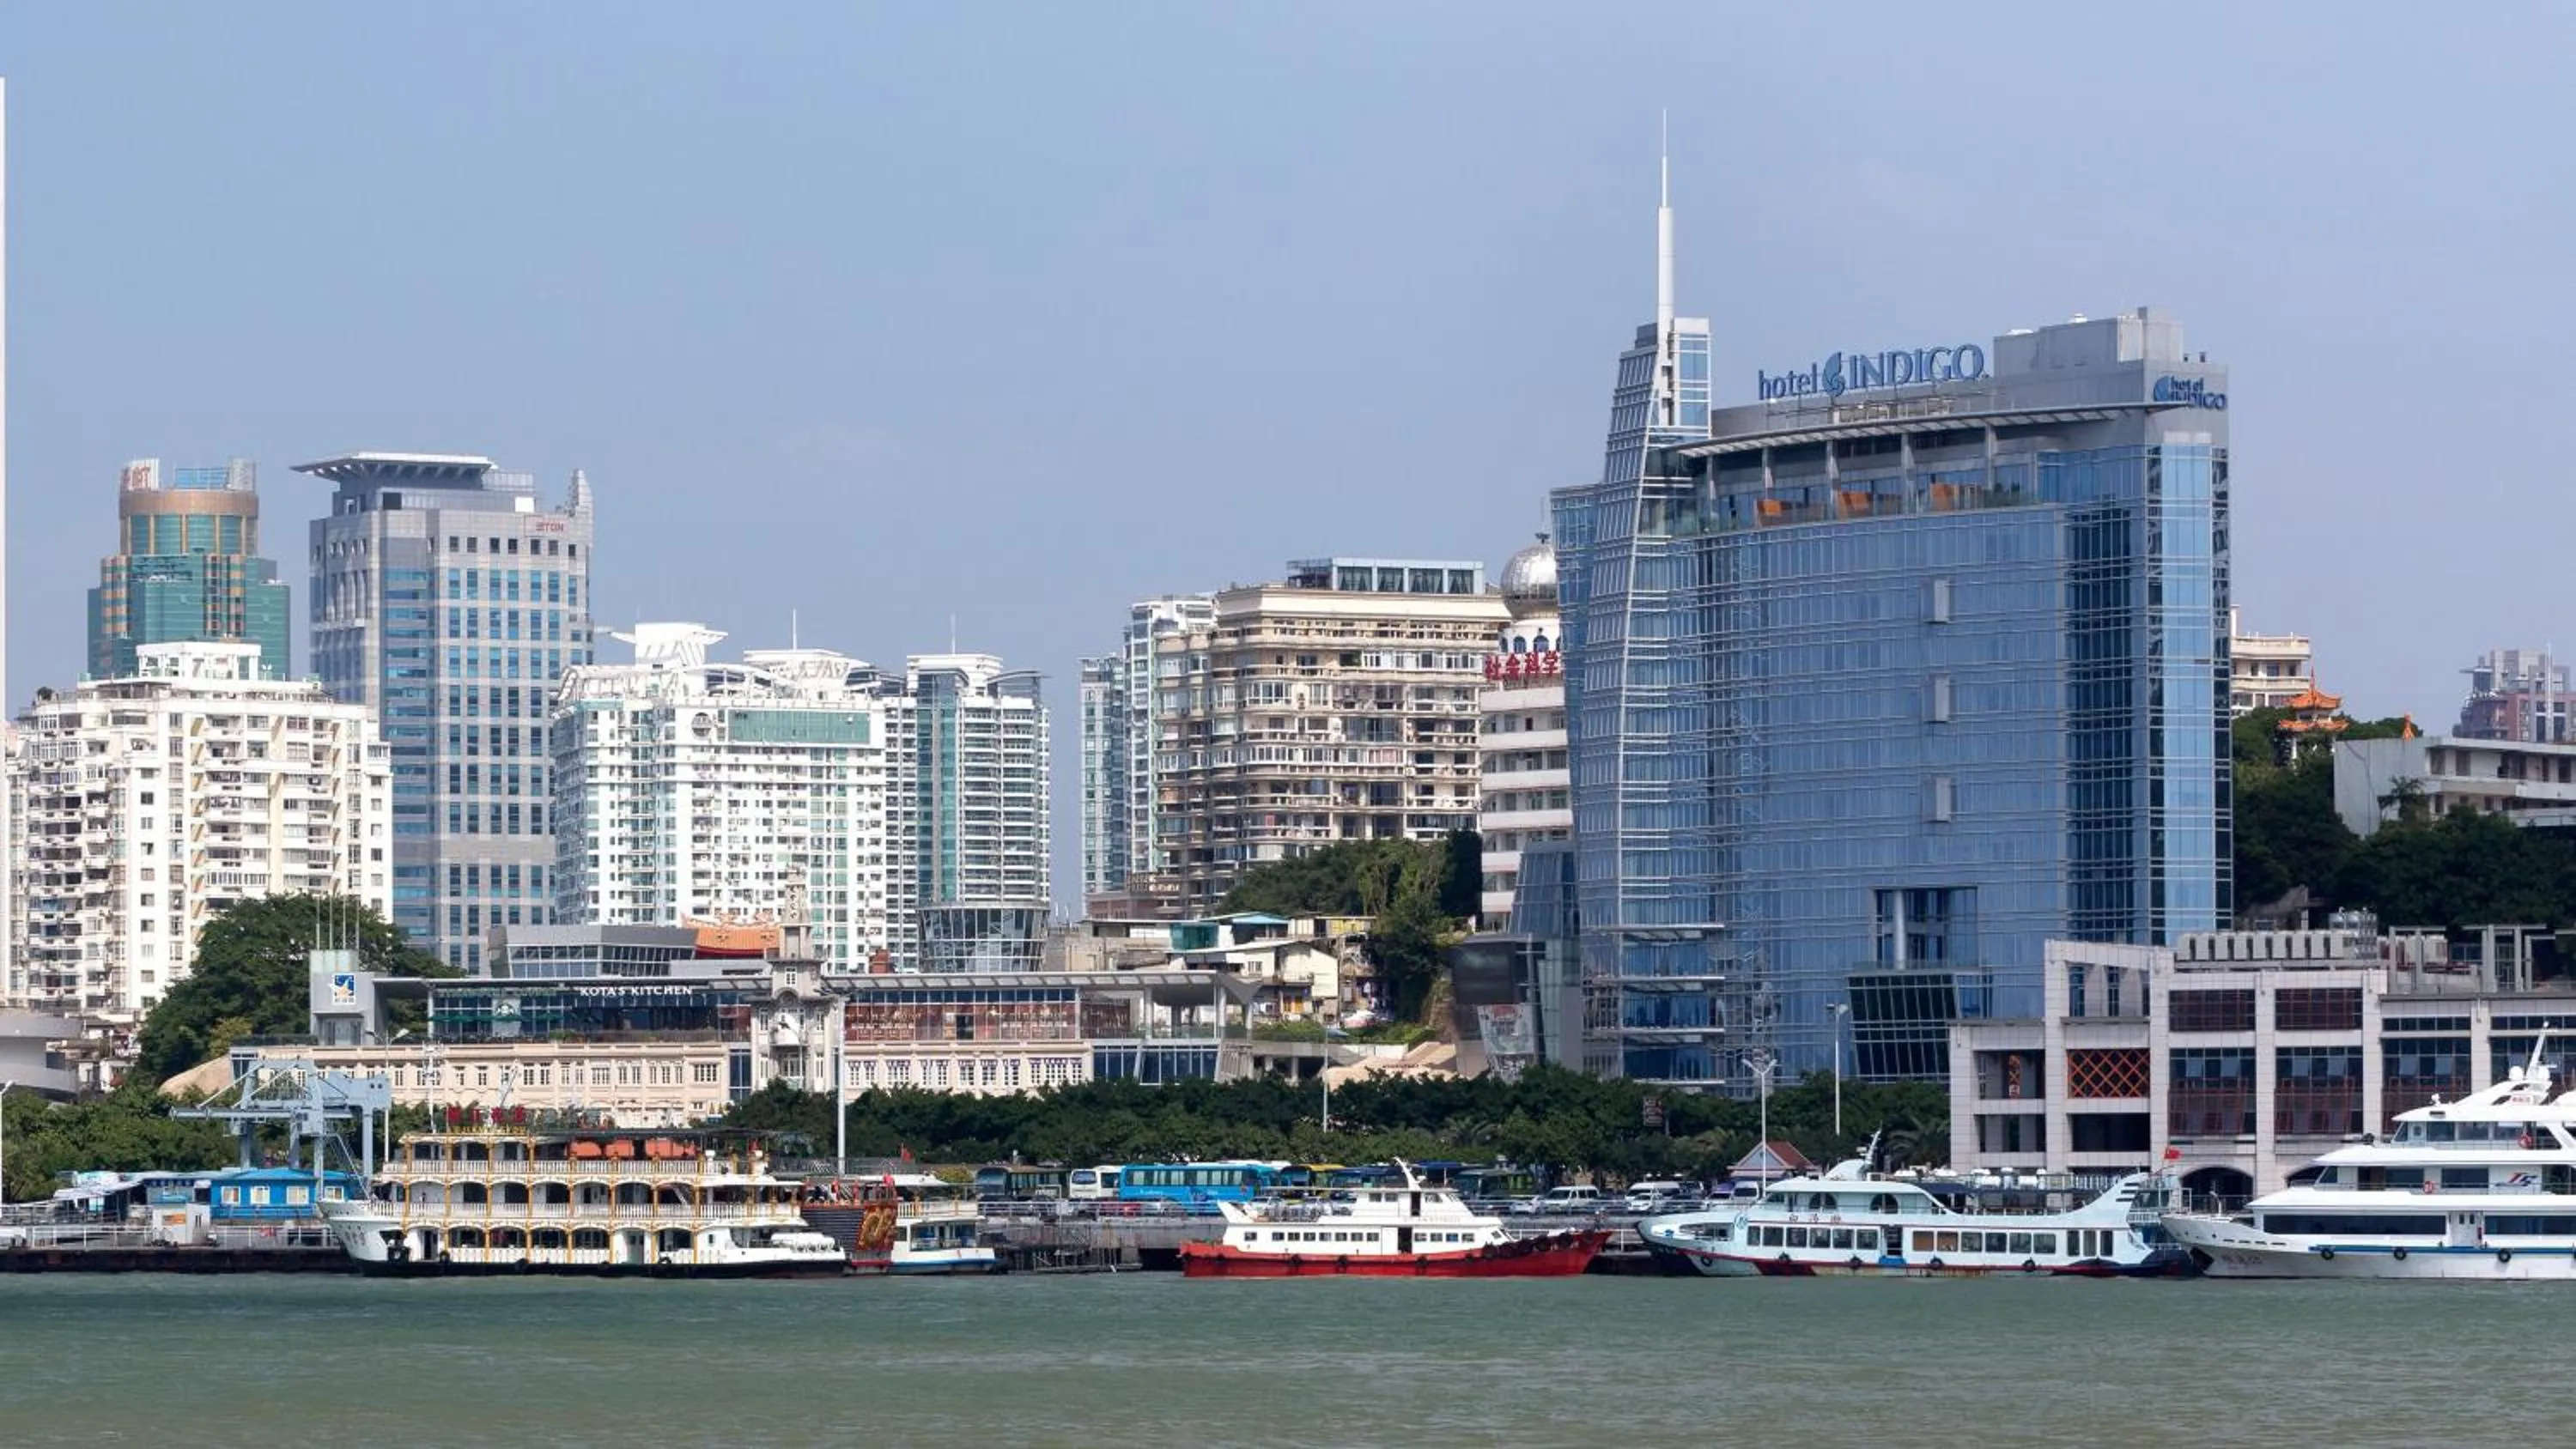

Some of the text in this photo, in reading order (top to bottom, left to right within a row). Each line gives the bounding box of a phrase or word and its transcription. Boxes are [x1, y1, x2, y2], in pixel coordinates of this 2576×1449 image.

[1759, 343, 1985, 400] hotel INDIGO
[2170, 375, 2204, 391] hotel
[580, 985, 693, 997] KOTA'S KITCHEN
